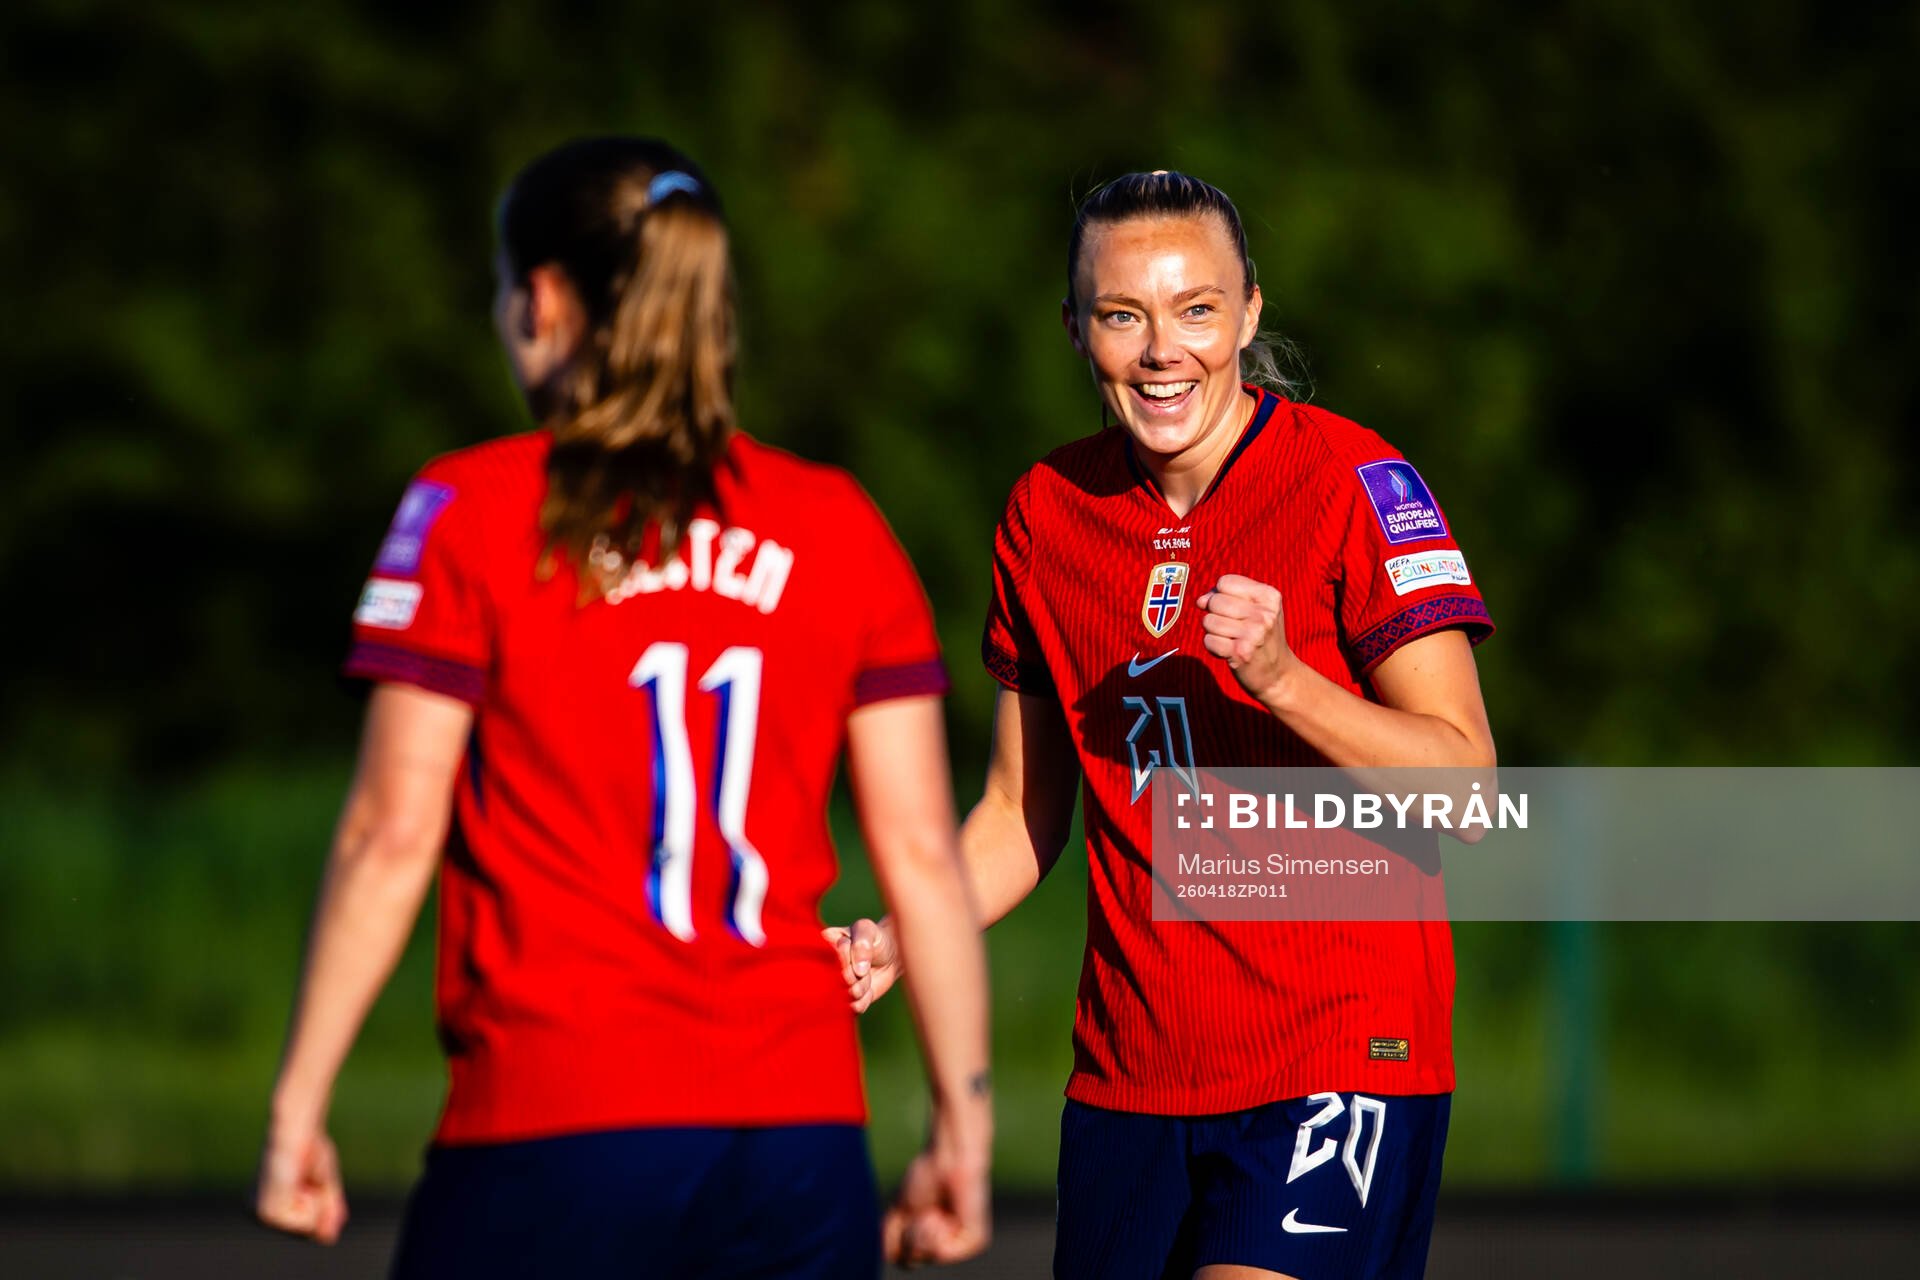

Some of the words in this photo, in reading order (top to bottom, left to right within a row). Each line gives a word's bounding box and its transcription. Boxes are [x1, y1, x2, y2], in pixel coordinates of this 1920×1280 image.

[1386, 509, 1434, 523] EUROPEAN
[1389, 518, 1438, 533] QUALIFIERS
[1389, 558, 1411, 570] UEFA
[1391, 559, 1464, 582] FOUNDATION
[1122, 696, 1200, 806] 20
[628, 641, 769, 949] 11
[1286, 1091, 1387, 1209] 20
